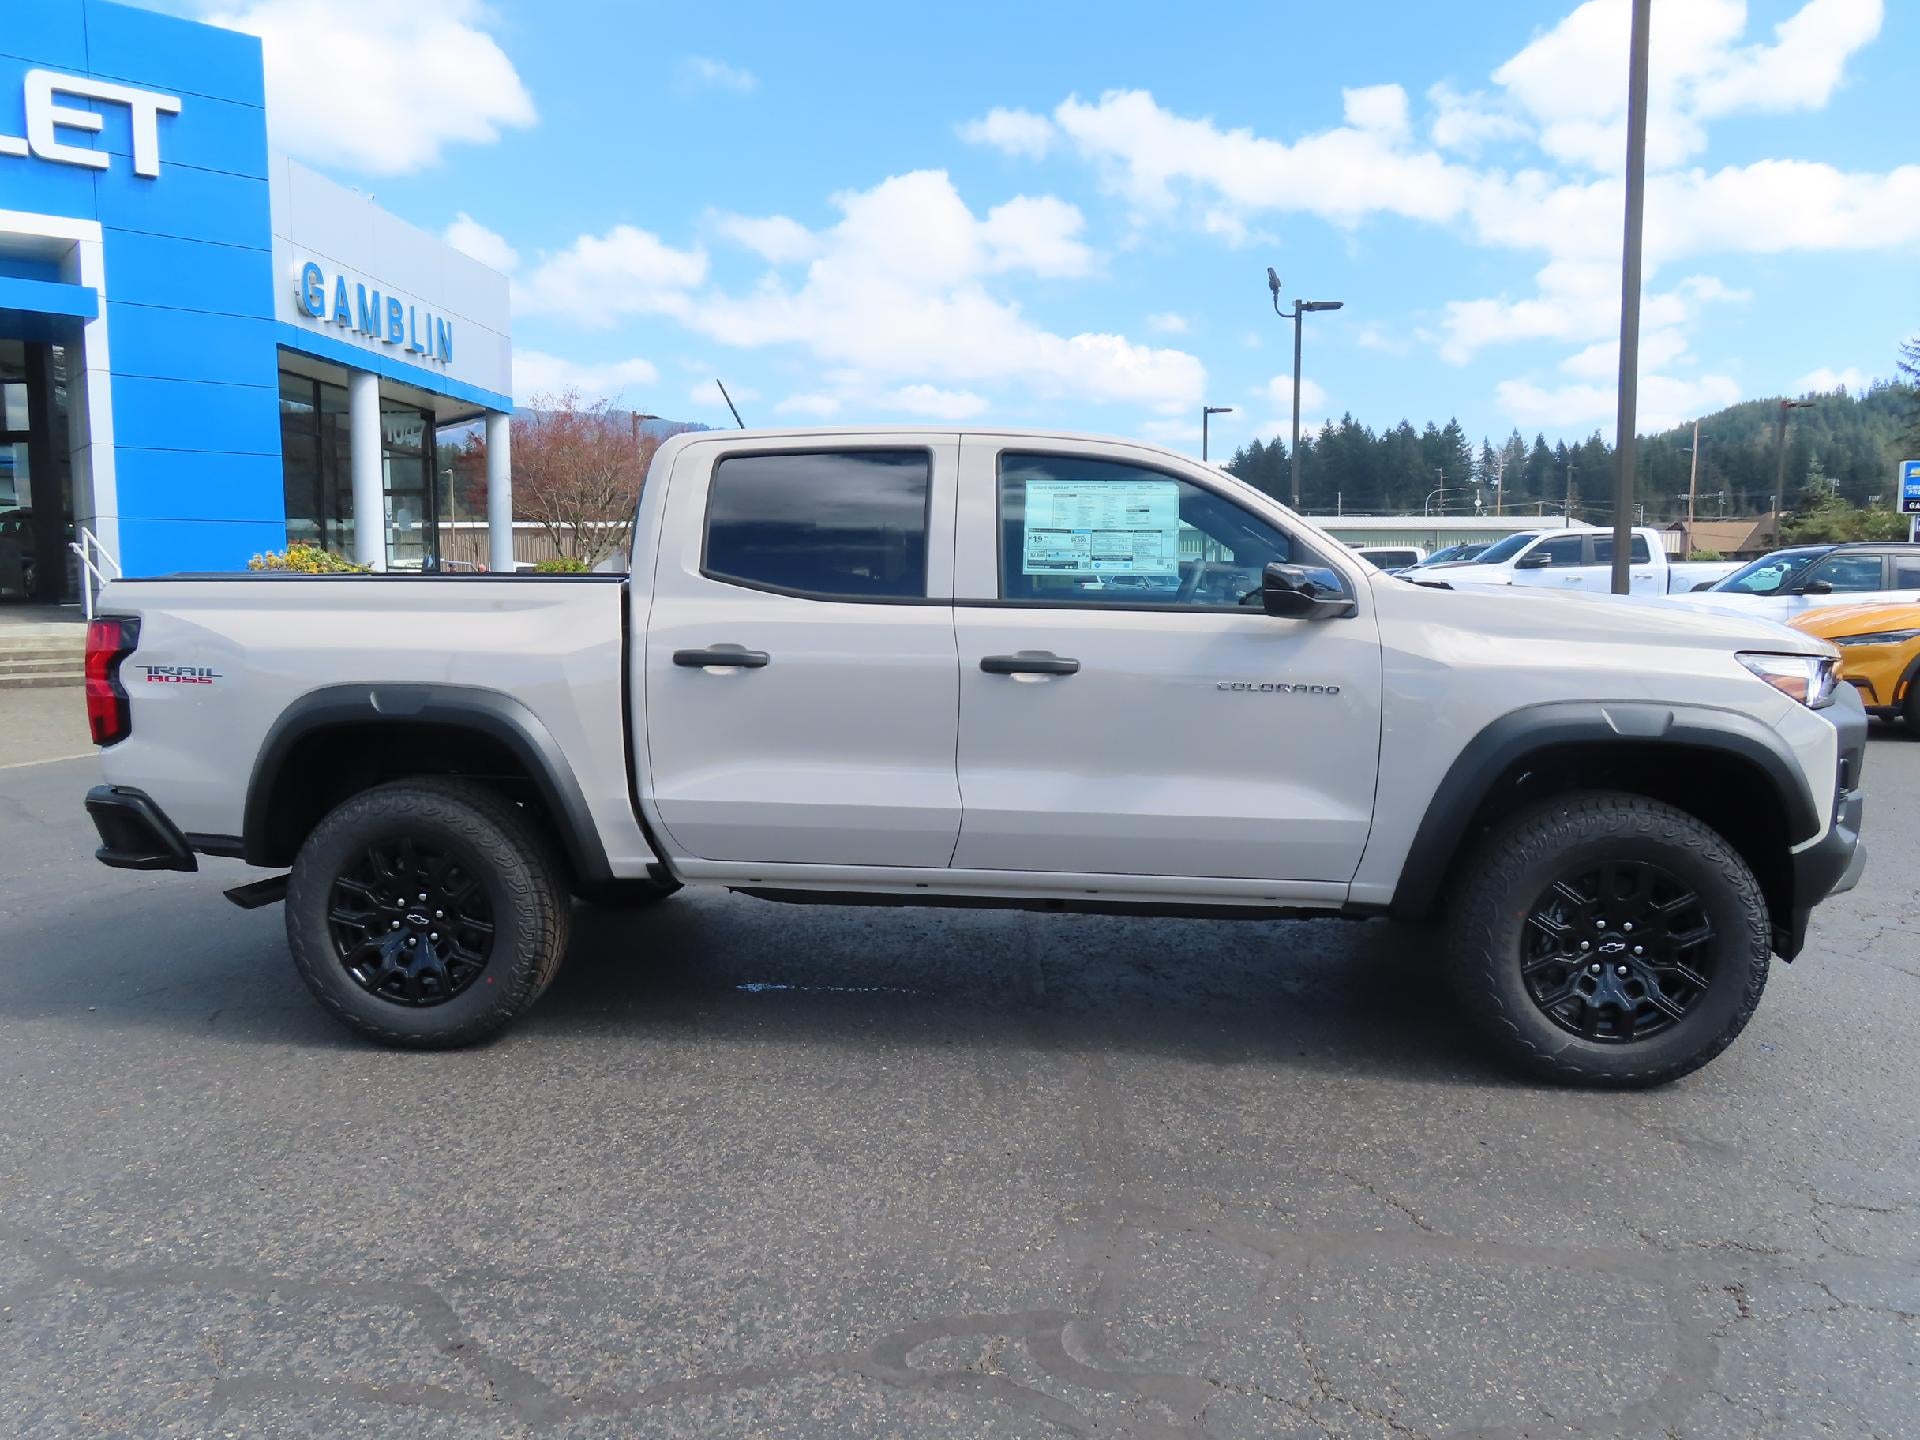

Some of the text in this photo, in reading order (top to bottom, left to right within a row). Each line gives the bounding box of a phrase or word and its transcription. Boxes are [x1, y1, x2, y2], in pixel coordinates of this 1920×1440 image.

[0, 69, 182, 179] ET
[298, 261, 453, 364] GAMBLIN
[136, 665, 223, 677] TRAIL
[1217, 682, 1340, 694] COLORADO
